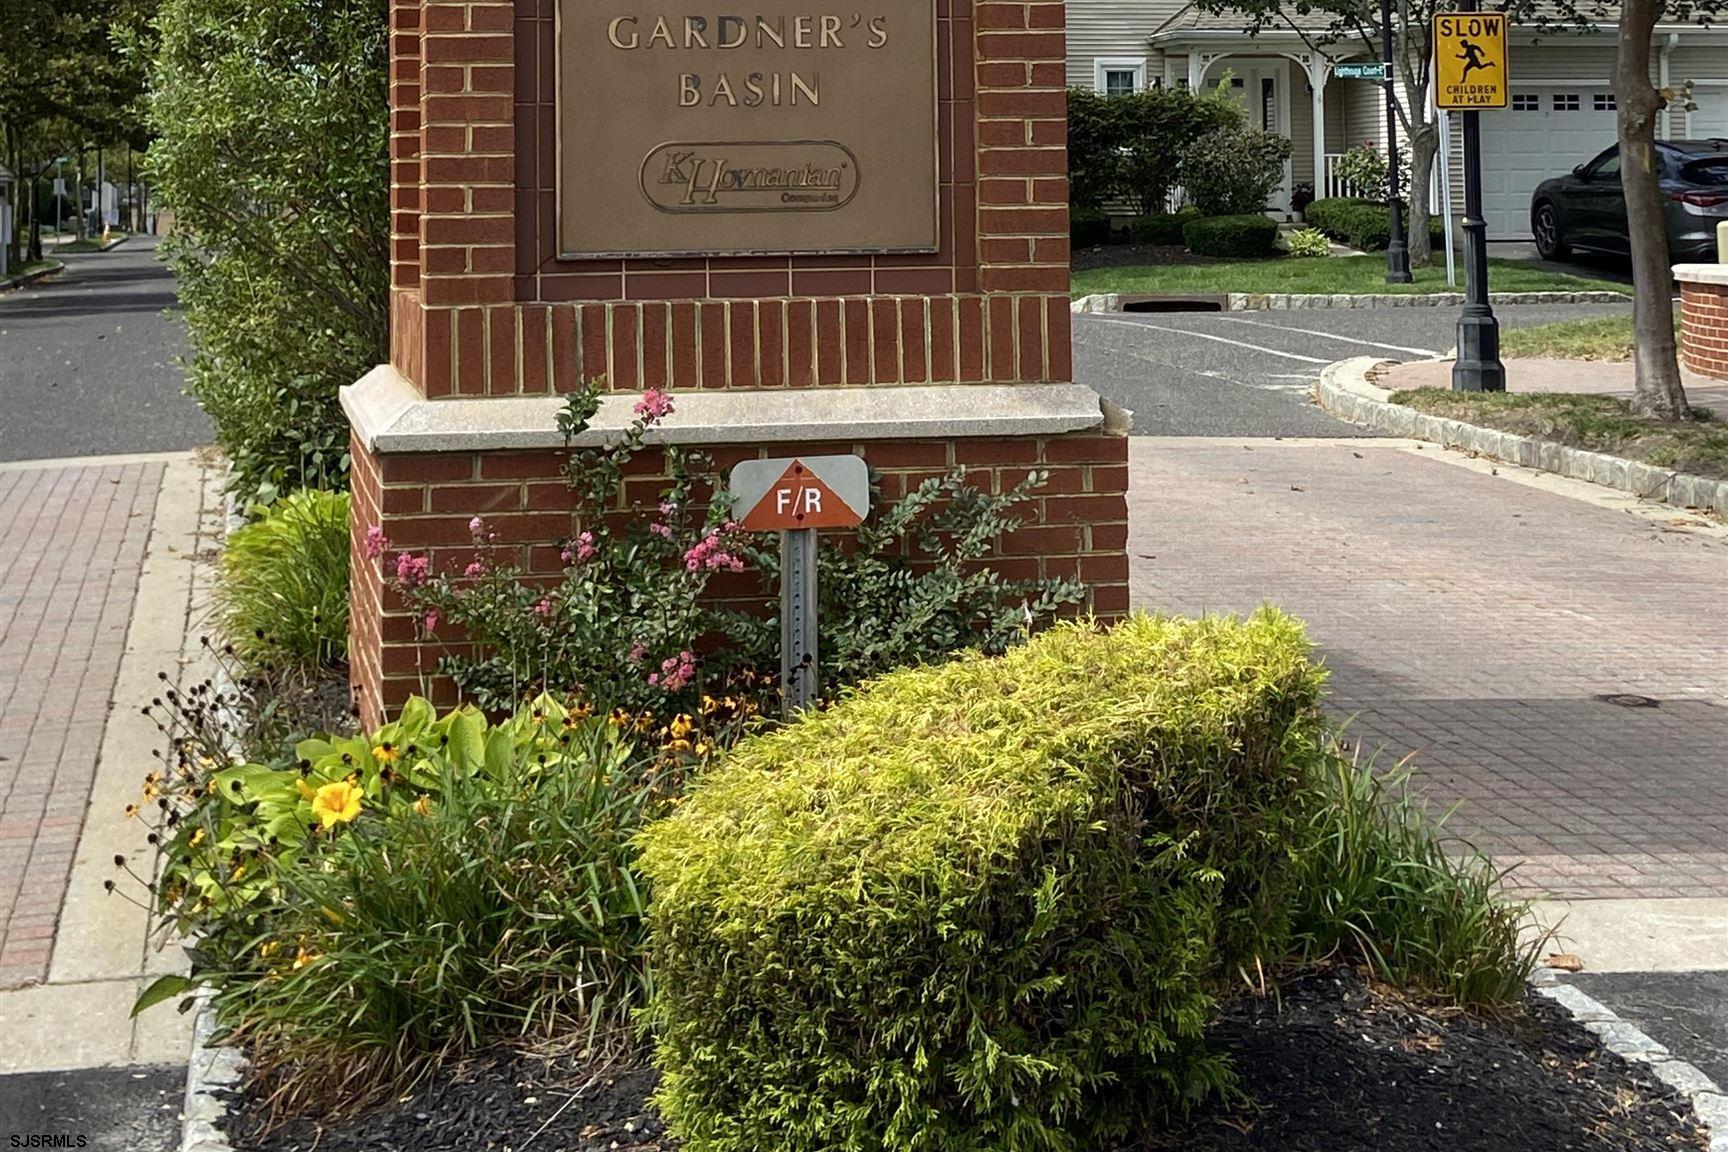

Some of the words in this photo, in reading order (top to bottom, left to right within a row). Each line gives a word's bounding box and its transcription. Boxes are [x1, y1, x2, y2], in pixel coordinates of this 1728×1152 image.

[607, 11, 889, 50] GARDNER'S
[1440, 18, 1500, 37] SLOW
[677, 71, 821, 108] BASIN
[1446, 84, 1497, 95] CHILDREN
[1452, 94, 1465, 104] AT
[1467, 94, 1492, 104] PLAY
[776, 485, 822, 517] F/R
